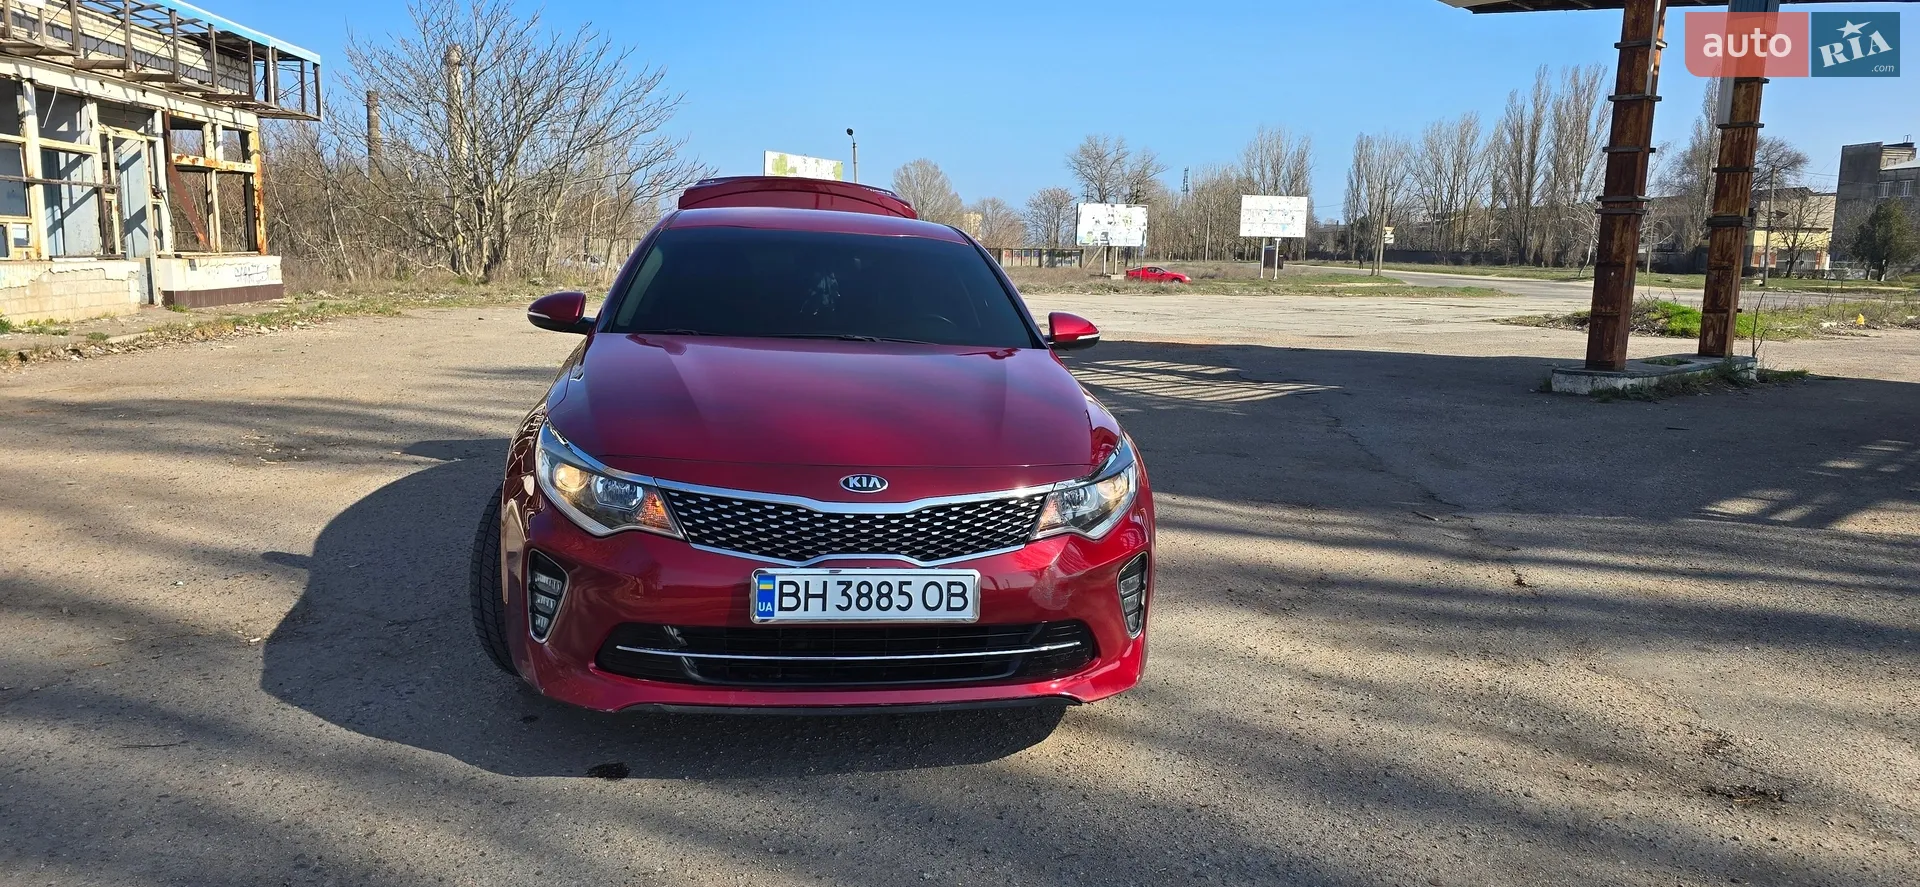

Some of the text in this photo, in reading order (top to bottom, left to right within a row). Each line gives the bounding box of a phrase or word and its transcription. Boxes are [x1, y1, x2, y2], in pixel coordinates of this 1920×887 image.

[848, 476, 882, 489] KIA
[777, 580, 970, 612] BH 3885 OB
[758, 601, 773, 612] UA
